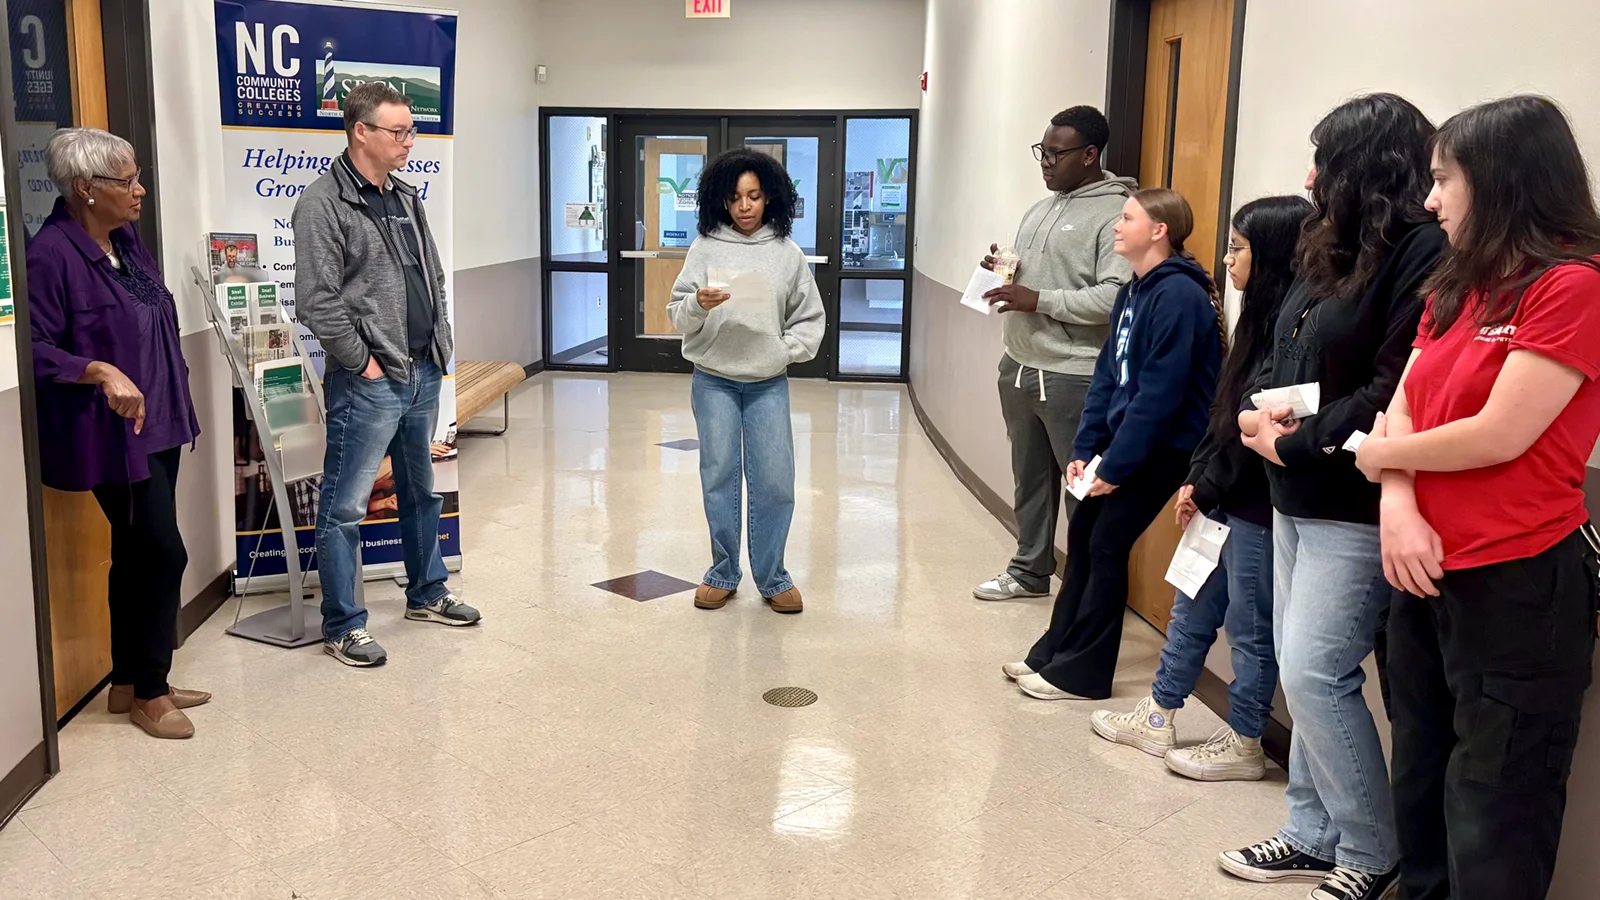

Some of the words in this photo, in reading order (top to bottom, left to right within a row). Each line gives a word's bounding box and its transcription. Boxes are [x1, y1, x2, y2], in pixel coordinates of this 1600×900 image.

[235, 21, 300, 77] NC
[236, 75, 301, 89] COMMUNITY
[237, 86, 302, 102] COLLEGES
[237, 102, 302, 111] CREATING
[238, 108, 302, 117] SUCCESS
[242, 148, 332, 175] Helping
[255, 178, 306, 198] Gro
